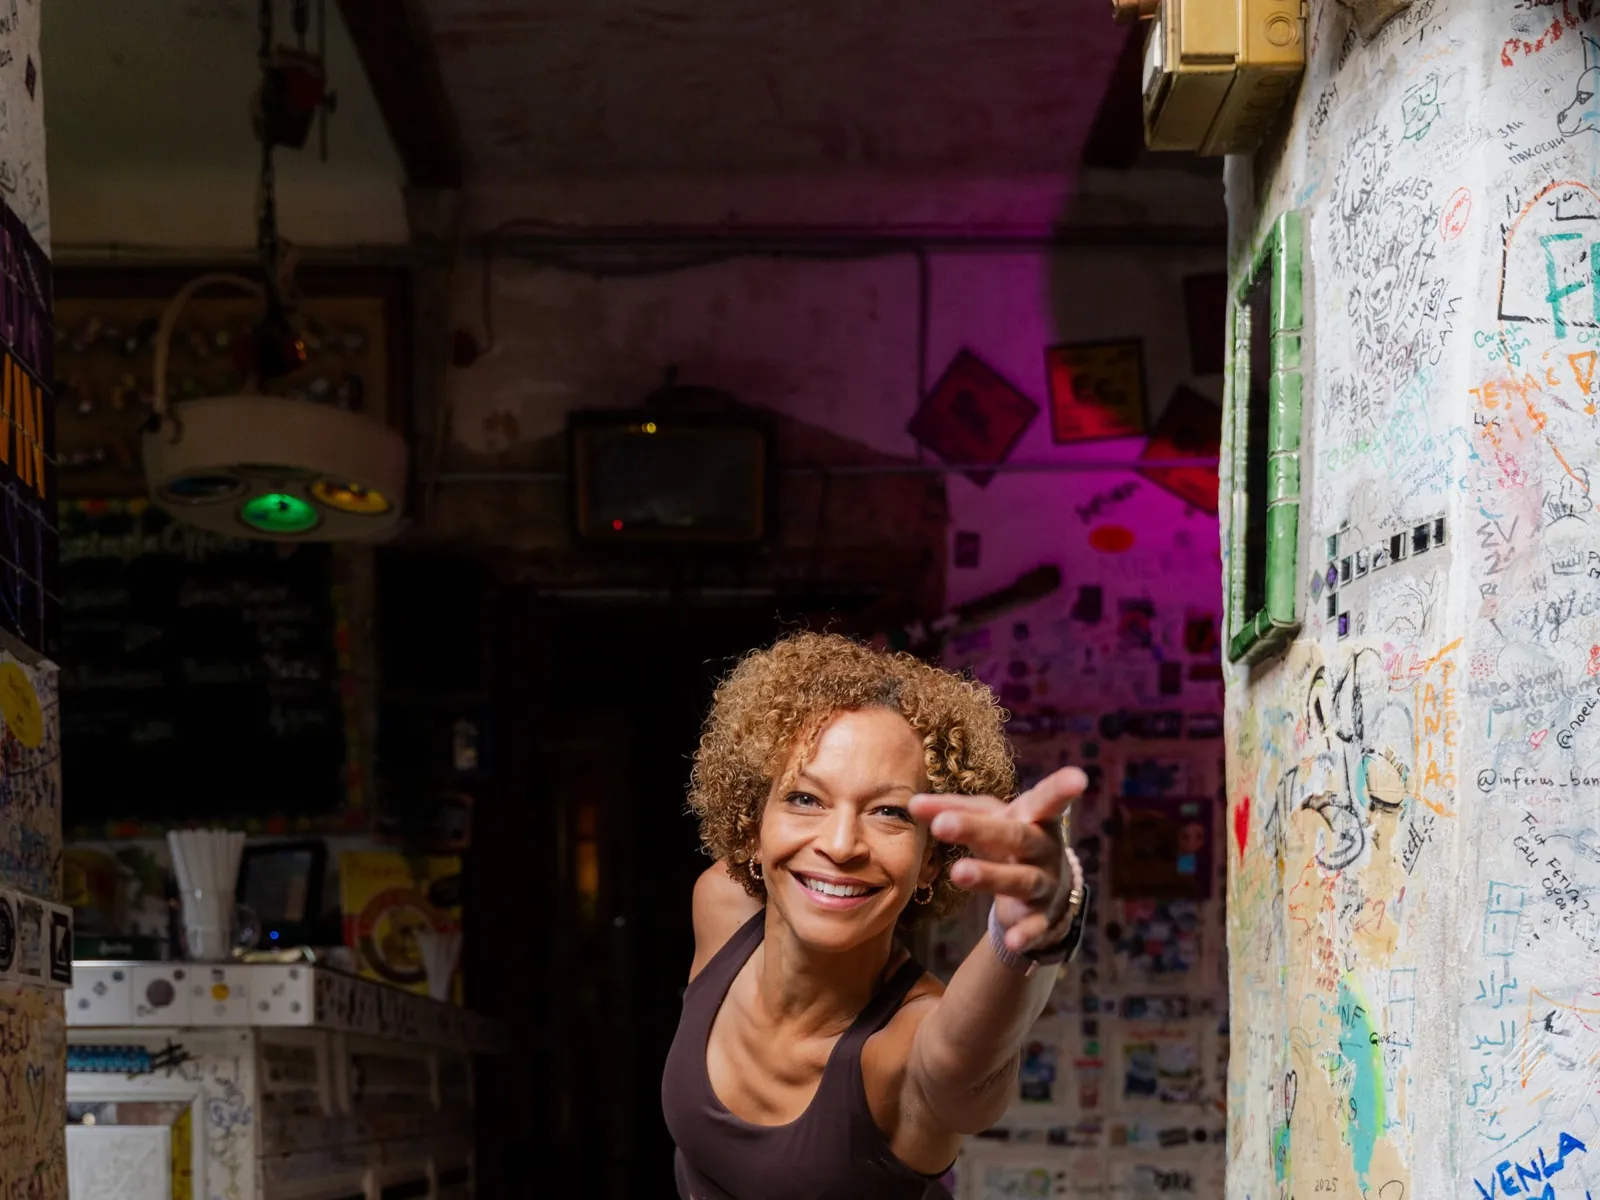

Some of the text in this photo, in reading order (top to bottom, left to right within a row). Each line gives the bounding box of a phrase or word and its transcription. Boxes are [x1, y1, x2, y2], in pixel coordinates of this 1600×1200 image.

[1497, 119, 1526, 139] ЗЛИ
[1508, 137, 1567, 165] ПАКОСНИ
[1314, 1176, 1339, 1193] 2025
